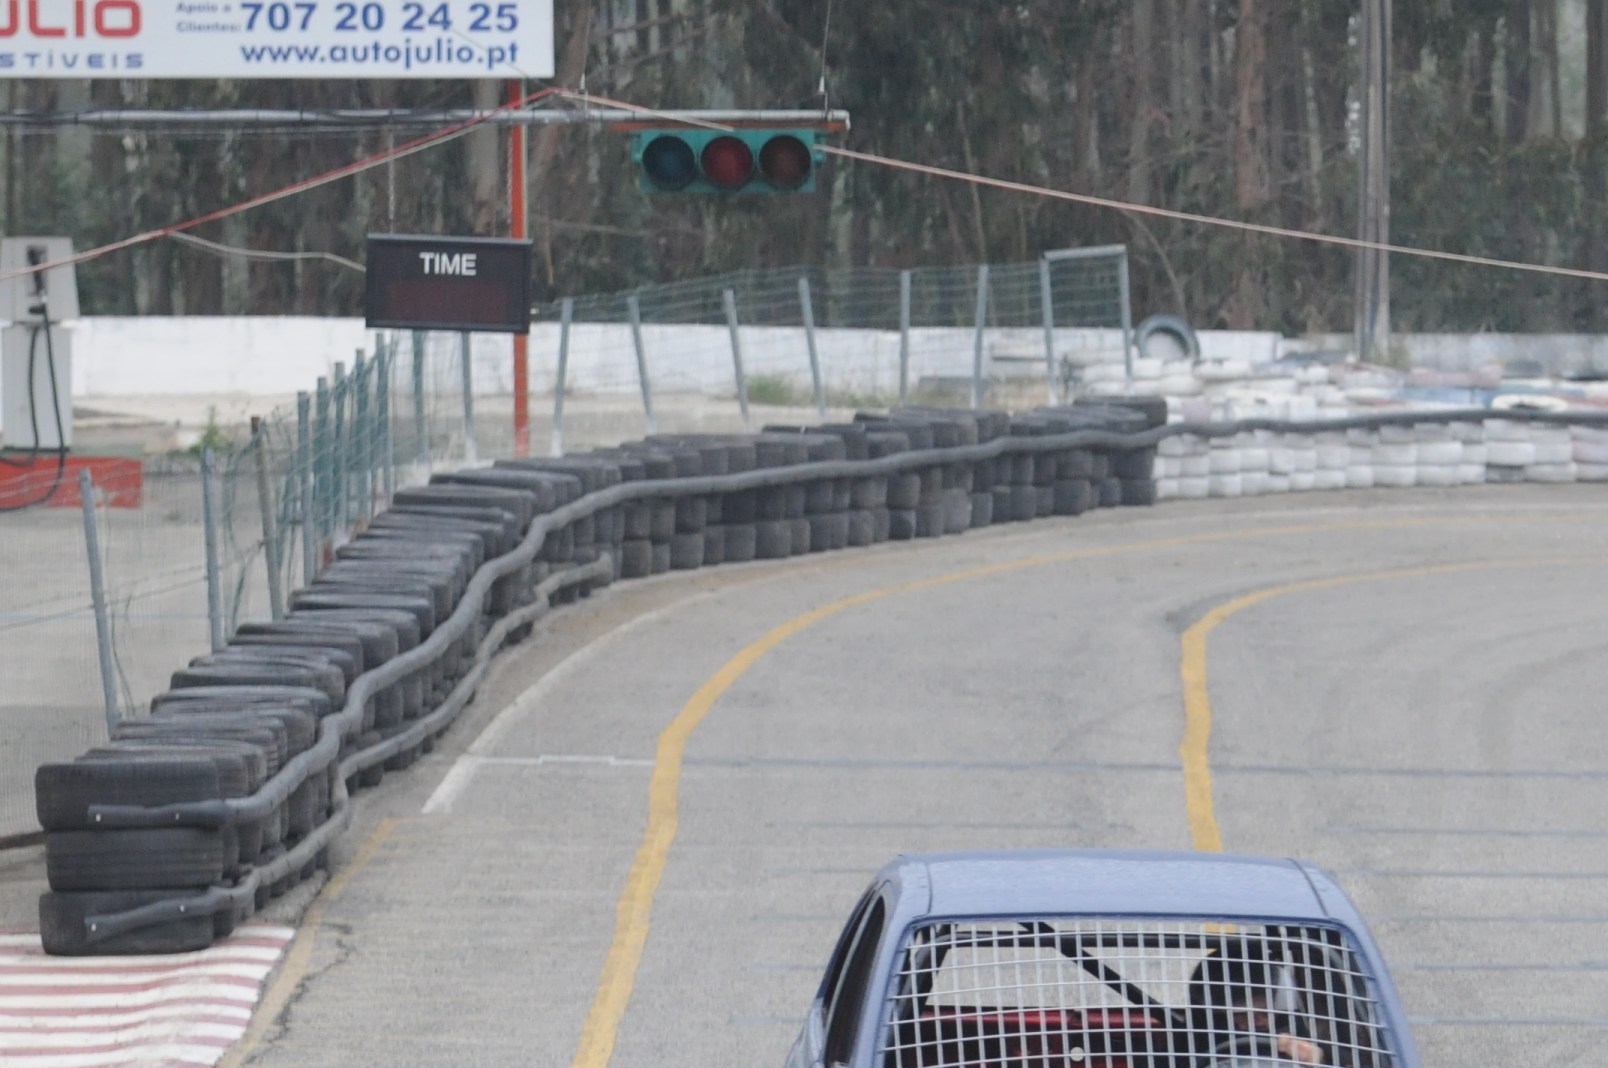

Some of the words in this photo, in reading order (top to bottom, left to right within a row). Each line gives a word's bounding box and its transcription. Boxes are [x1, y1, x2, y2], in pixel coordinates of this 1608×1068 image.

[241, 2, 317, 31] 707
[335, 2, 385, 31] 20
[402, 2, 451, 31] 24
[469, 2, 519, 31] 25
[241, 38, 517, 70] www.autojulio.pt
[419, 251, 477, 276] TIME
